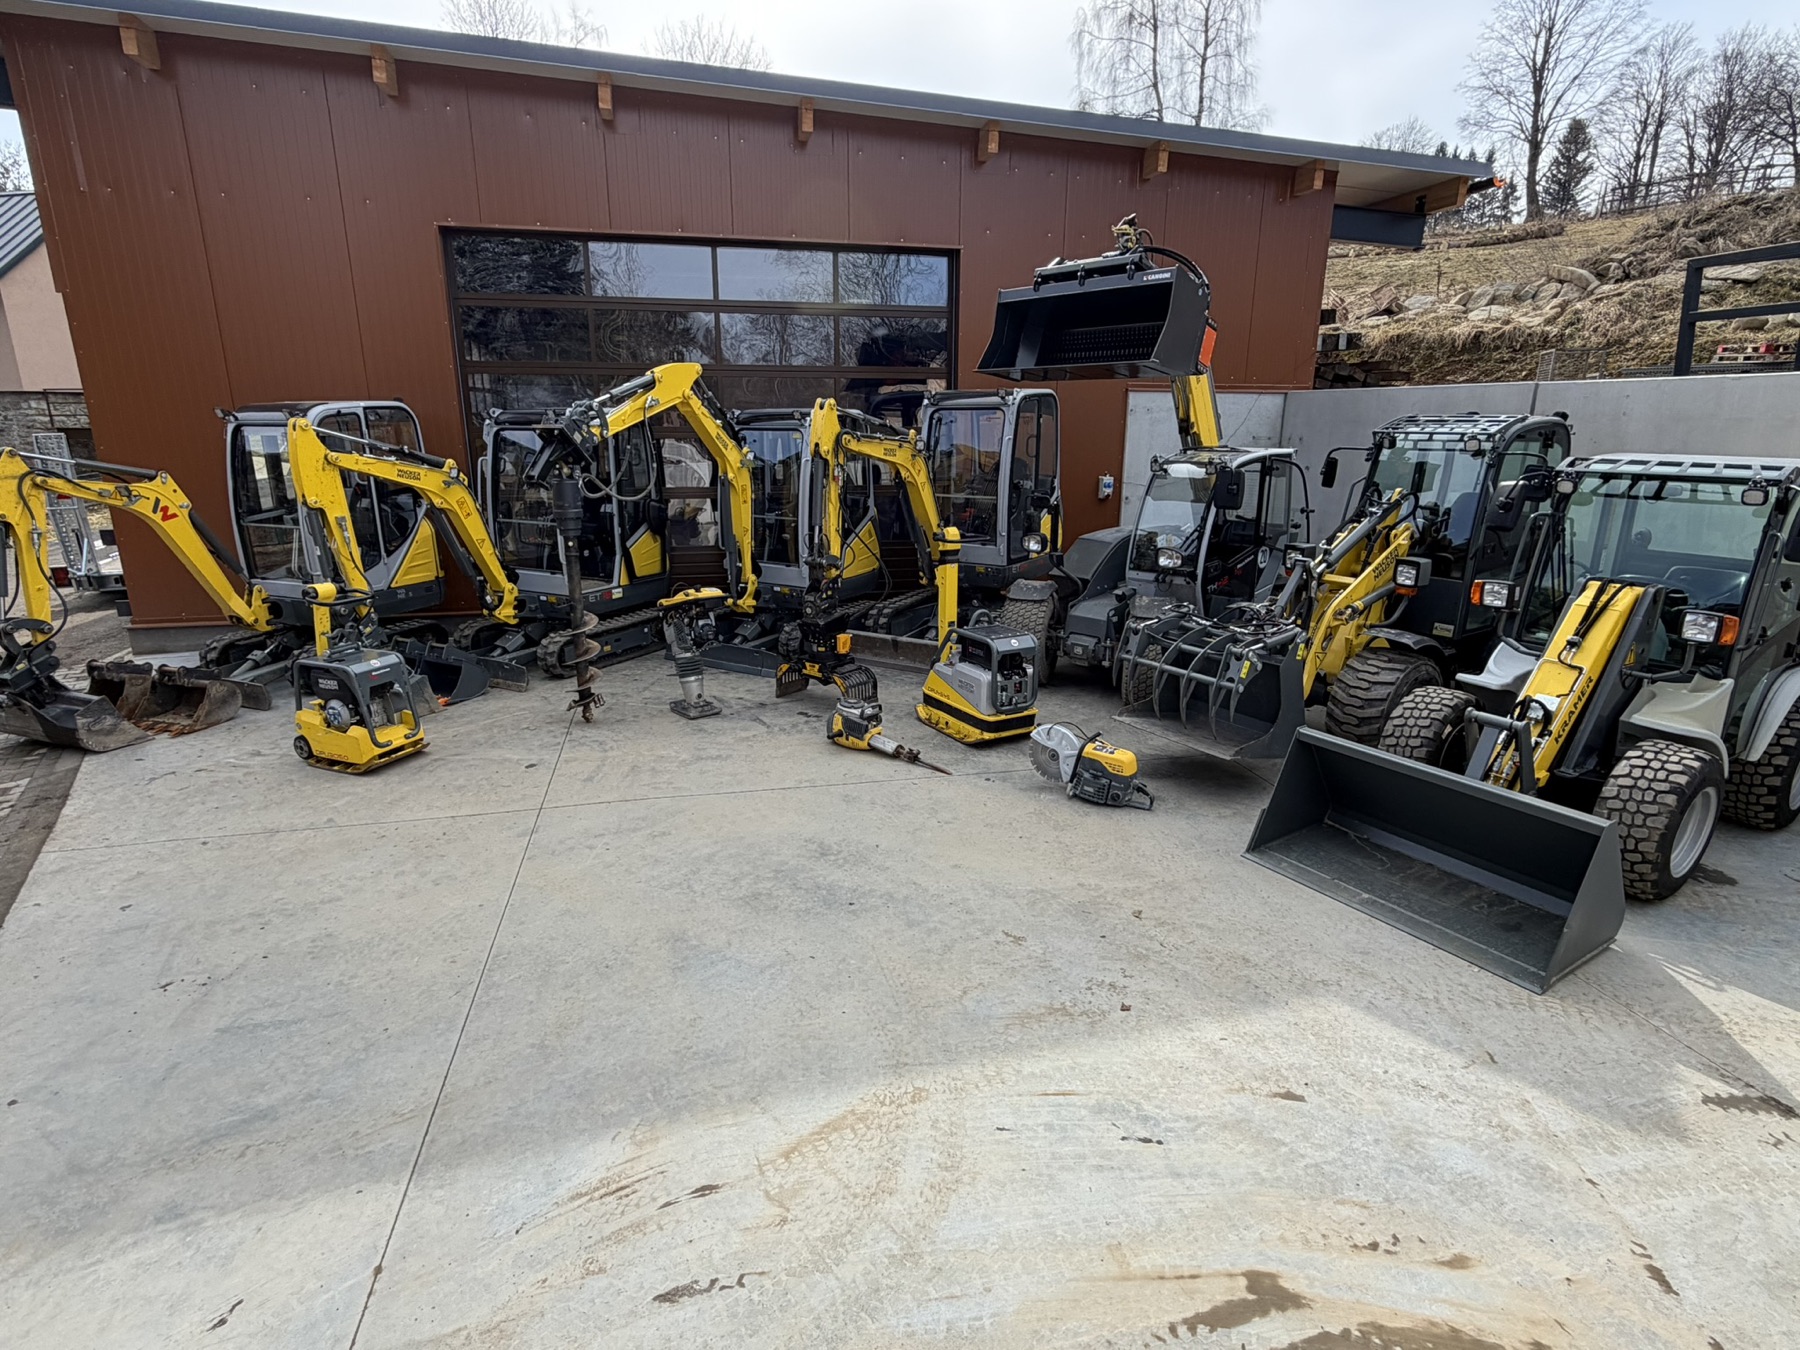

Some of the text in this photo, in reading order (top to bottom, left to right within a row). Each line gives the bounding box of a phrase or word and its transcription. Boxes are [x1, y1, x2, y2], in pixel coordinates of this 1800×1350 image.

[397, 468, 421, 477] WACKER
[397, 472, 421, 481] NEUSON
[1260, 548, 1268, 564] 20
[1373, 546, 1399, 574] WACKER
[318, 678, 338, 686] WACKER
[1554, 675, 1594, 745] KRAMER
